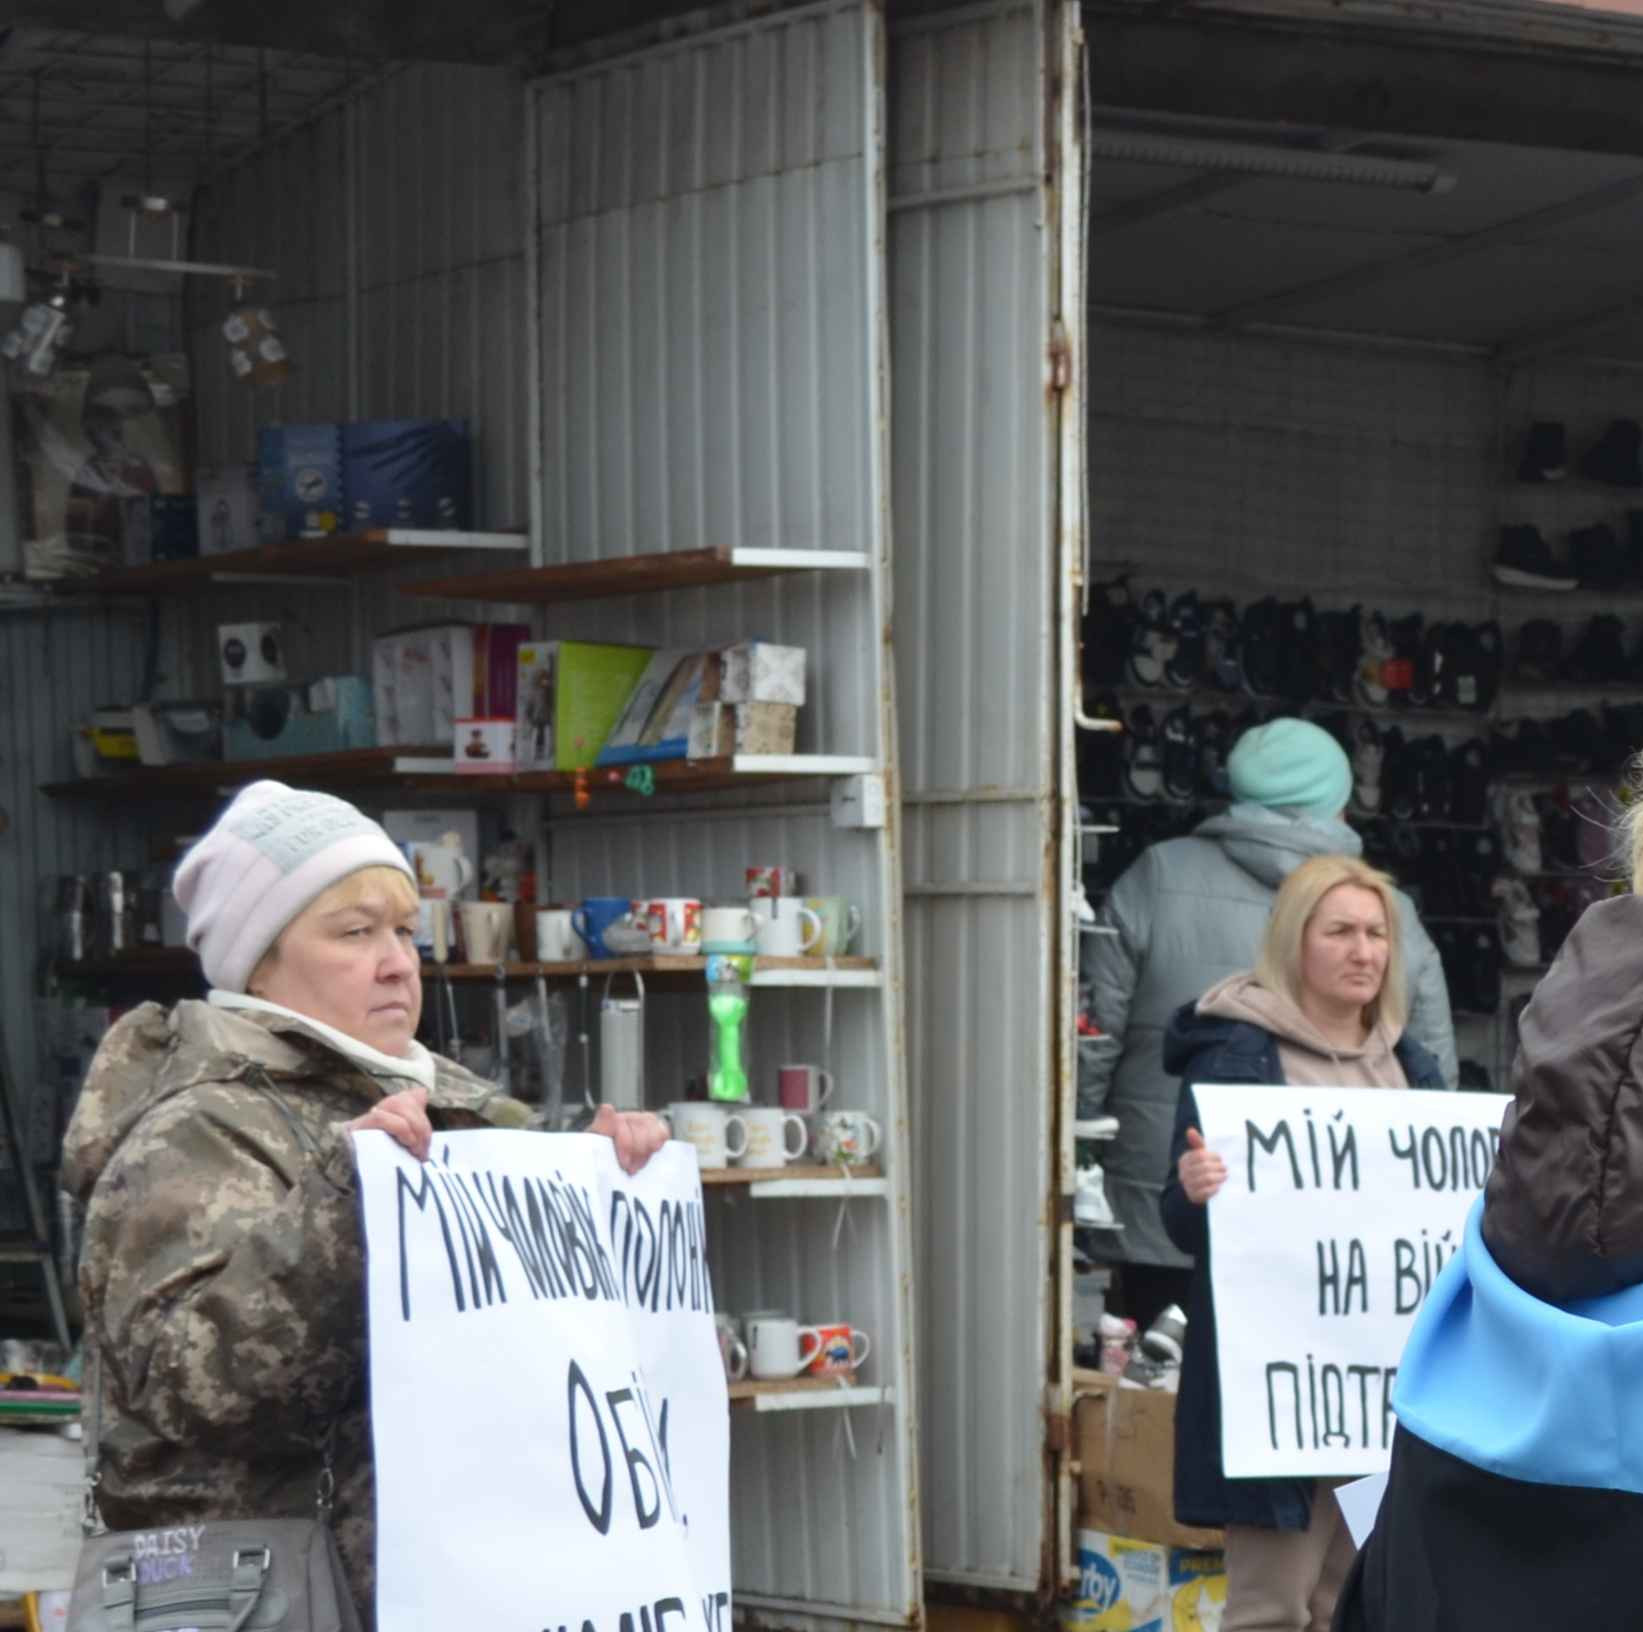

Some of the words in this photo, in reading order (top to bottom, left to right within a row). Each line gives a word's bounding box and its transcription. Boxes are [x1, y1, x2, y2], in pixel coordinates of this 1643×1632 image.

[1245, 1108, 1360, 1192] МІЙ
[1316, 1238, 1369, 1316] НА
[1265, 1353, 1398, 1450] ПІДТР
[1080, 1561, 1118, 1609] rby
